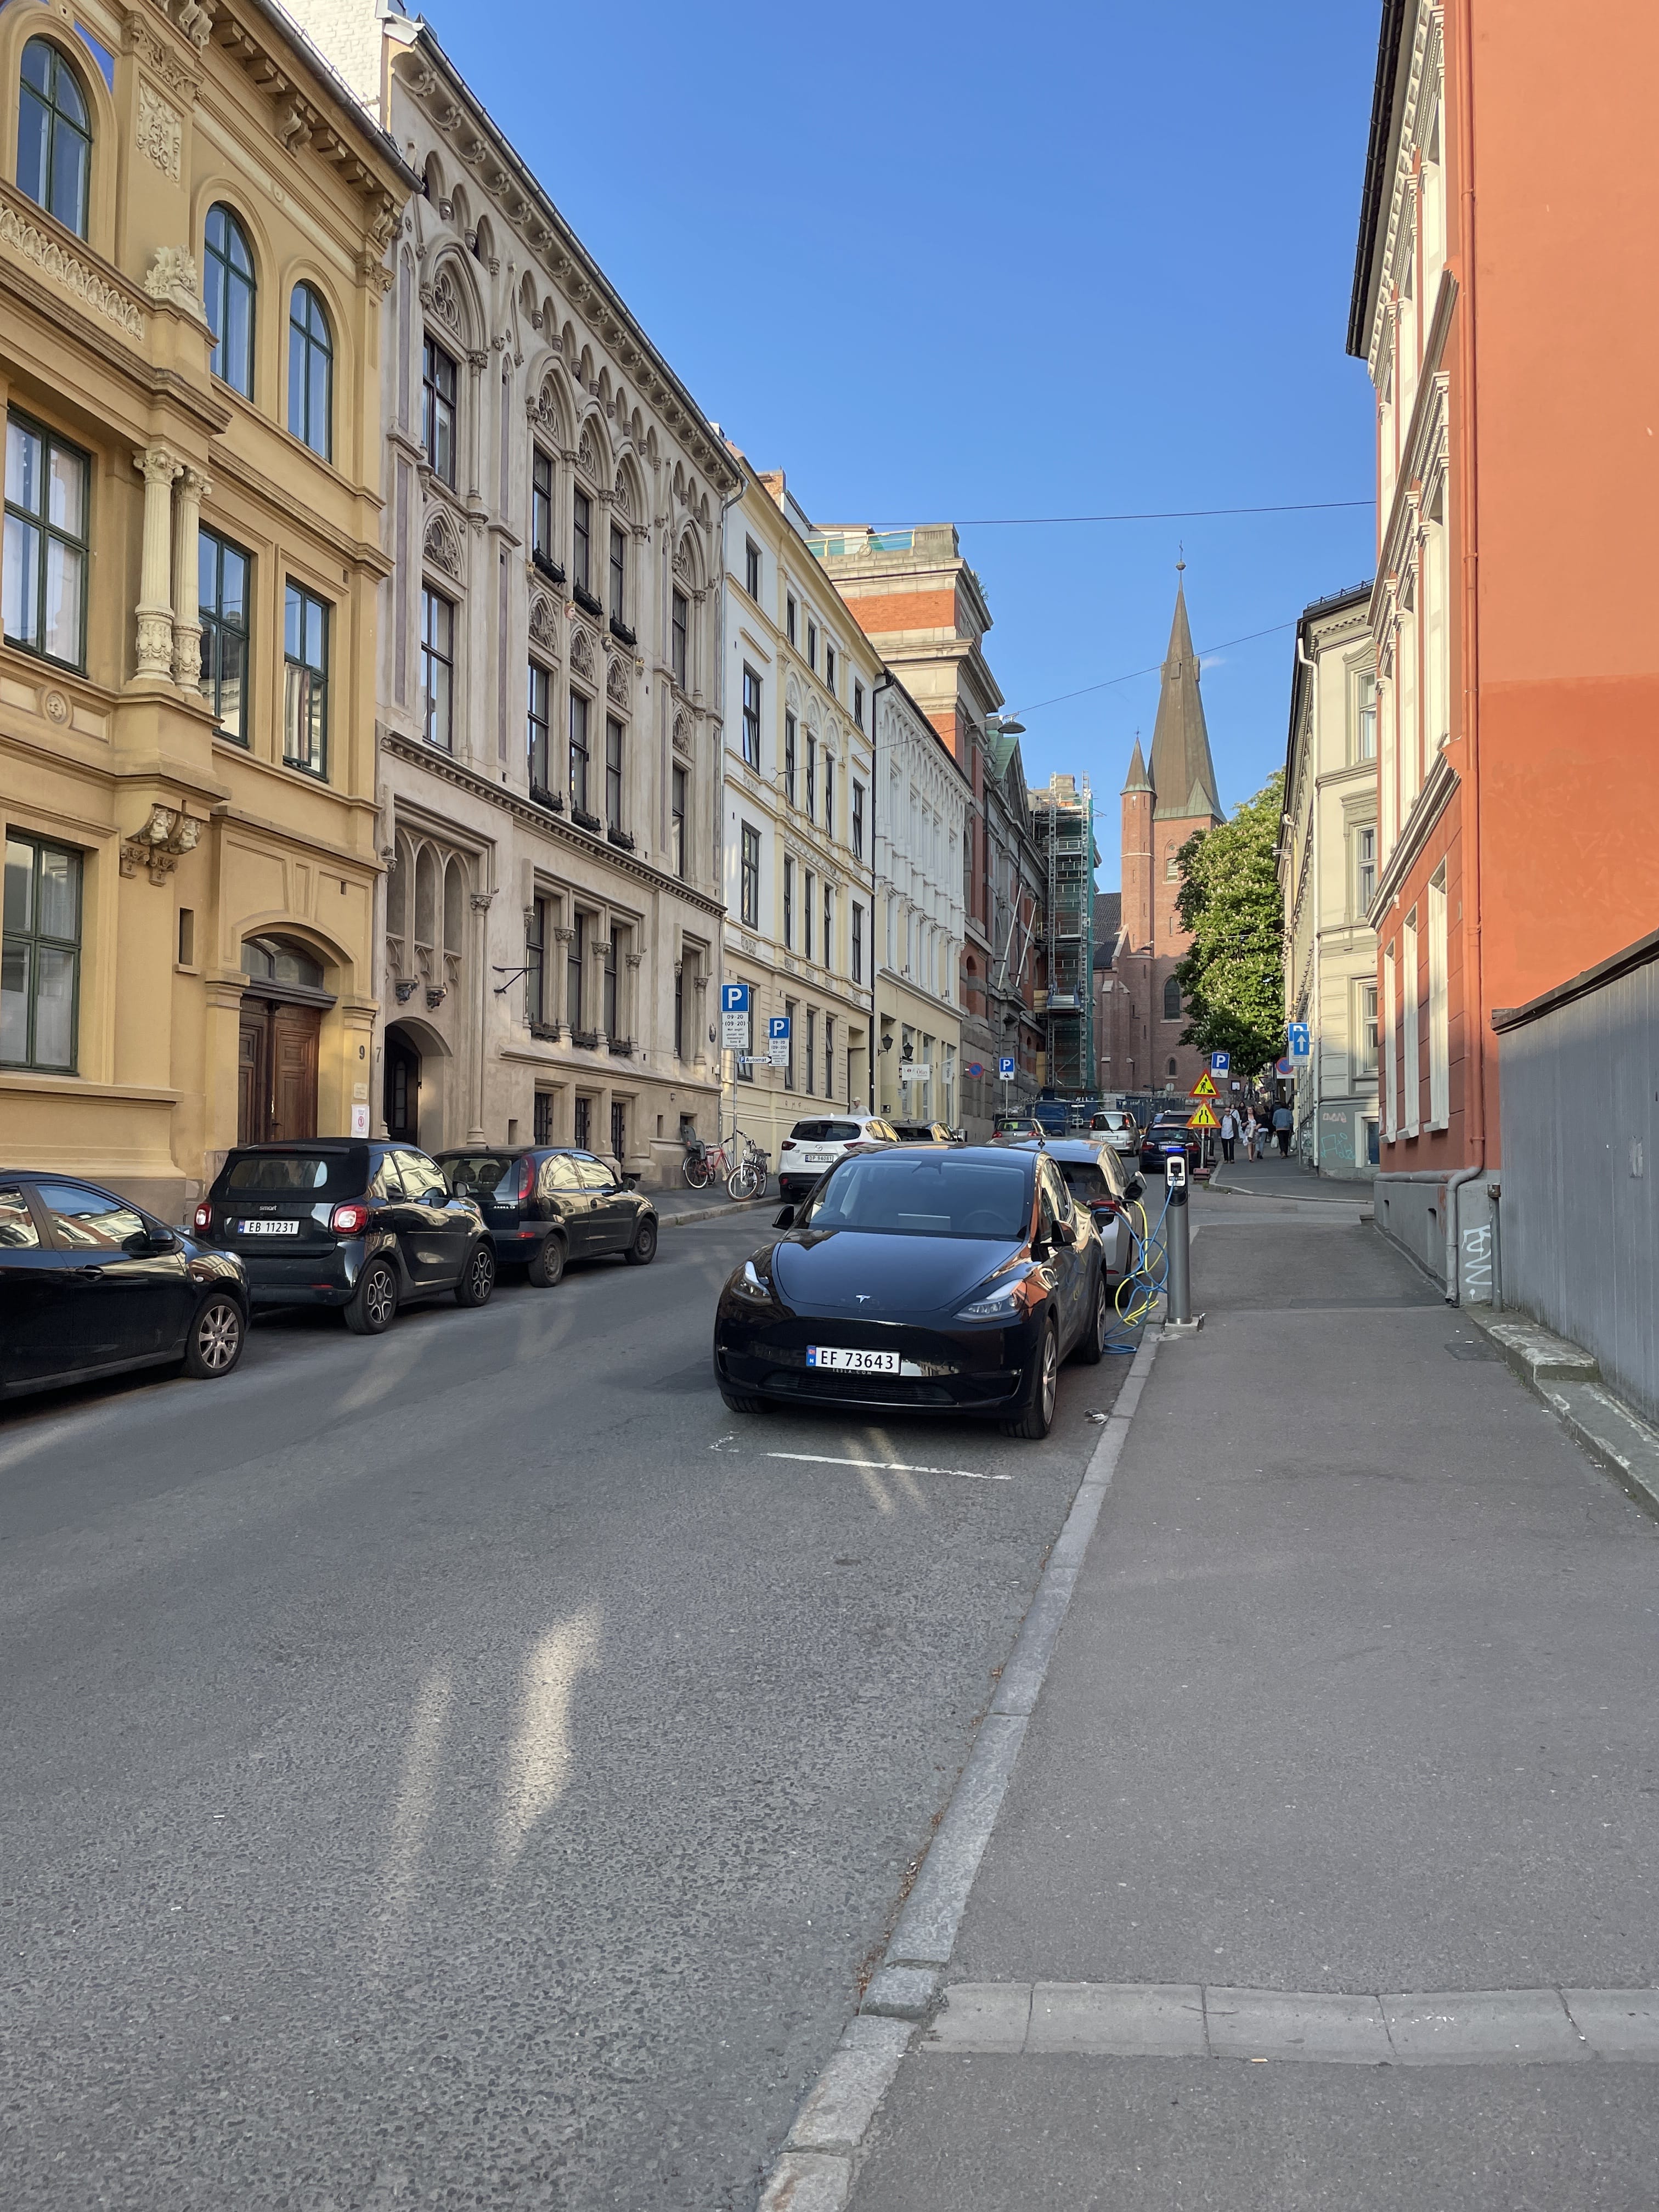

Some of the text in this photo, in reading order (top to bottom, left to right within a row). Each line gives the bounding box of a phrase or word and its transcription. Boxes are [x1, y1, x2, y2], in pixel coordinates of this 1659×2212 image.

[728, 988, 742, 1008] P
[774, 1020, 785, 1036] P
[359, 1045, 365, 1060] 9
[376, 1047, 382, 1063] 7
[1003, 1059, 1011, 1070] P
[1216, 1055, 1226, 1067] P
[249, 1222, 294, 1232] EB 11231
[821, 1351, 893, 1369] EF 73643
